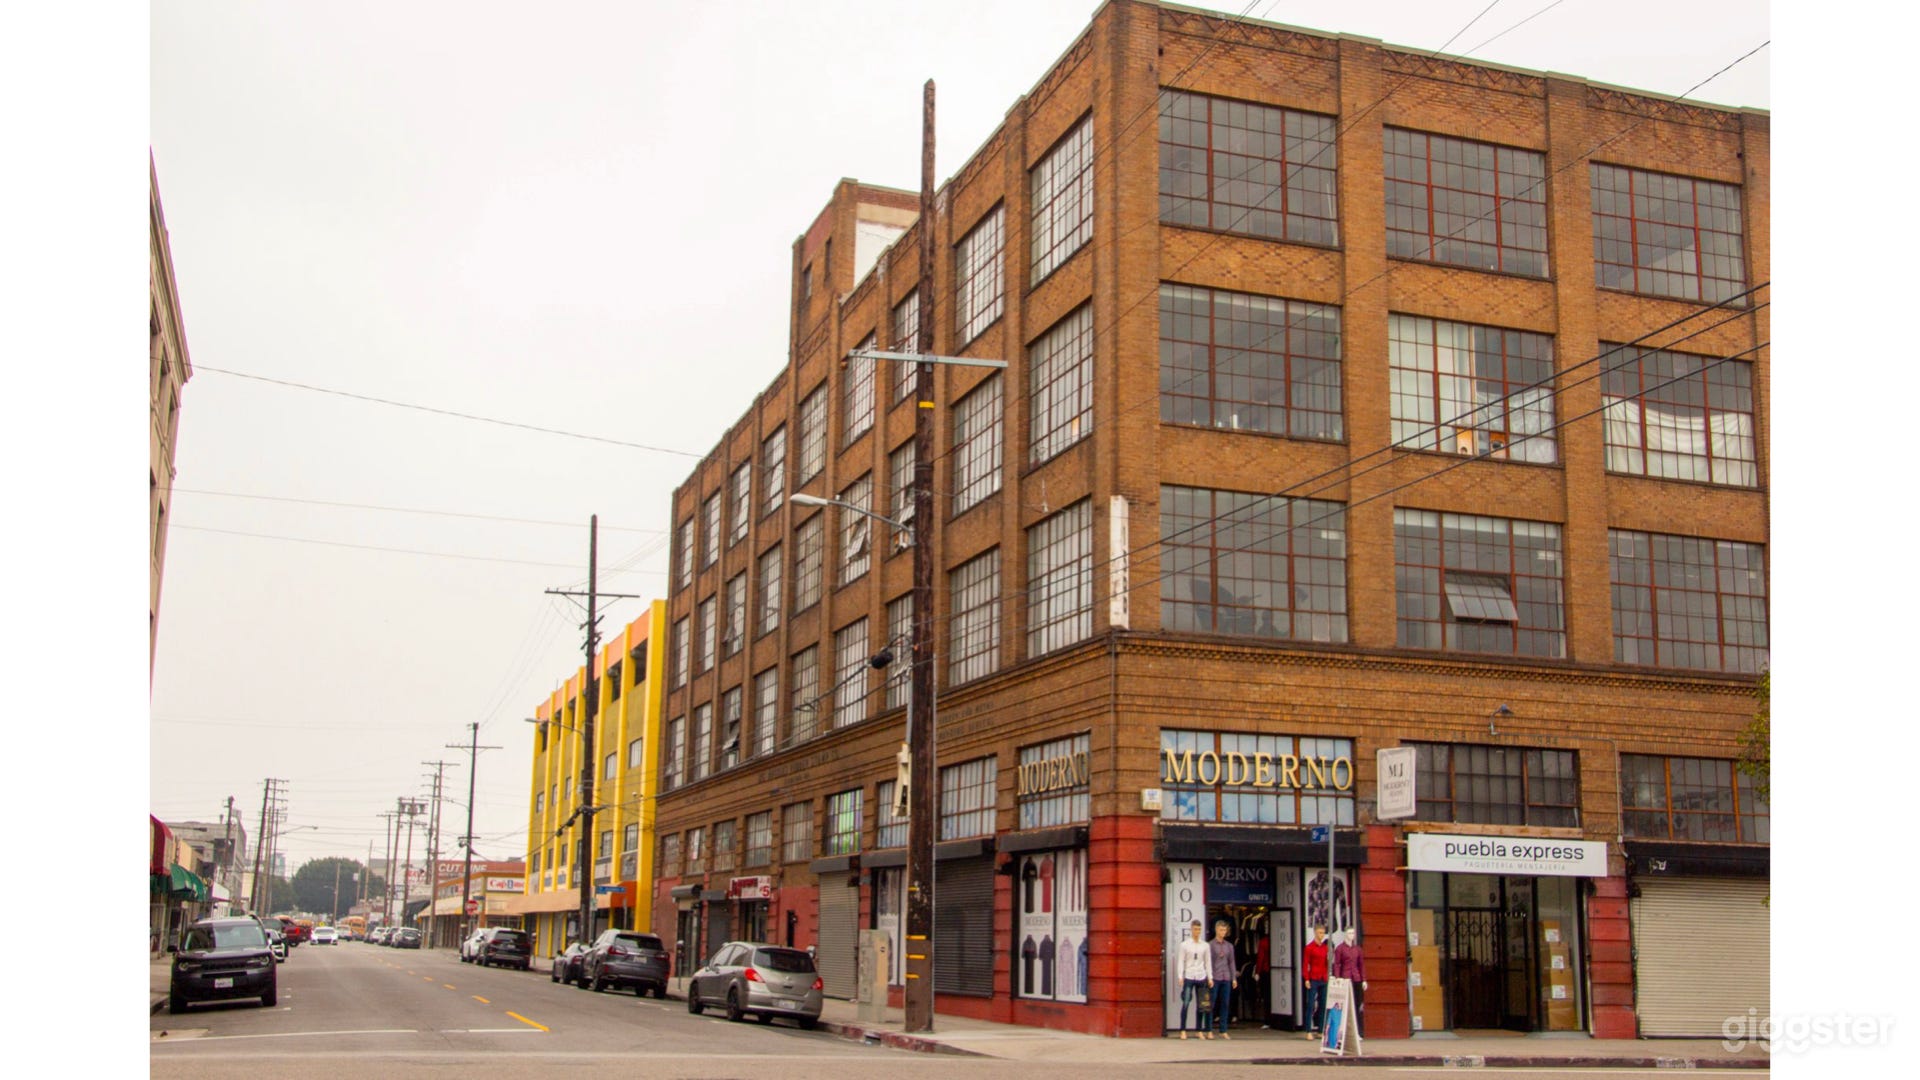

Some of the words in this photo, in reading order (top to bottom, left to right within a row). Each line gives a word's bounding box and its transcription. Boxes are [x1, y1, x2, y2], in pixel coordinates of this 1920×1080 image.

[1017, 750, 1089, 796] MODERNO
[1164, 748, 1354, 791] MODERNO
[1445, 840, 1506, 858] puebla
[1512, 846, 1584, 861] express
[438, 863, 461, 873] CUT
